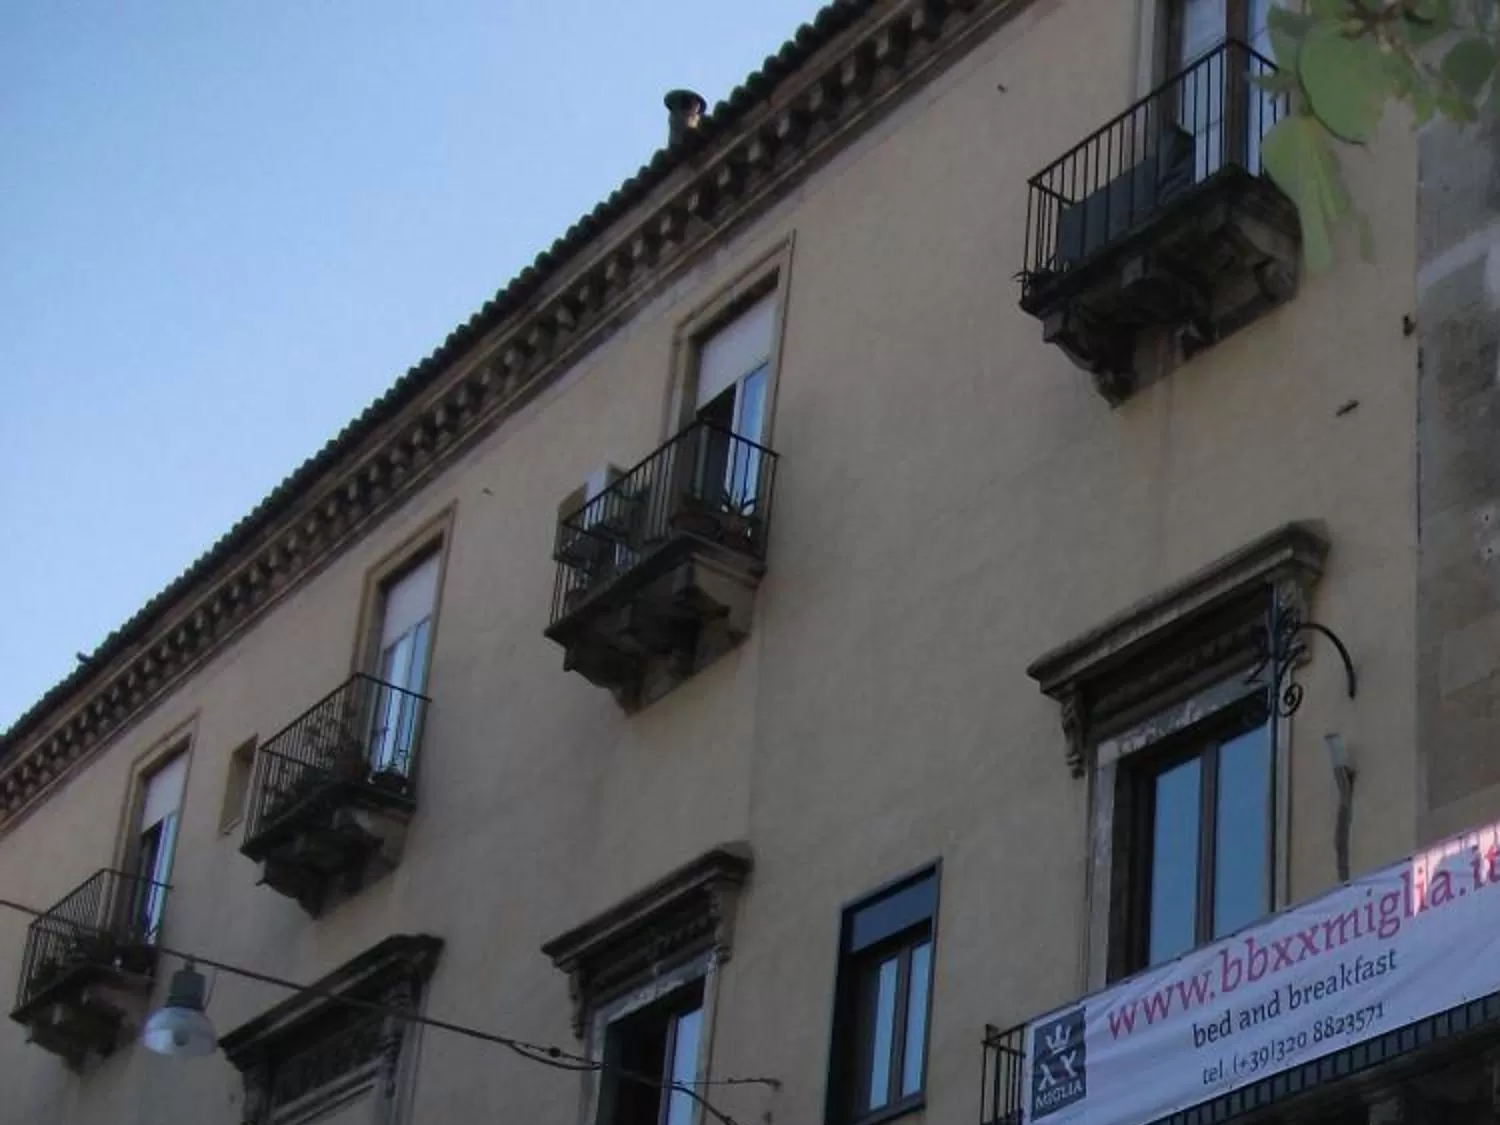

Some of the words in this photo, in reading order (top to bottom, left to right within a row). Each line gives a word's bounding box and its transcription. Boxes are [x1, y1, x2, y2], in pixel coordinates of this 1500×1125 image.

[1192, 1008, 1232, 1048] bed
[1239, 990, 1281, 1030] and
[1288, 949, 1397, 1010] breakfast
[1313, 1000, 1384, 1042] 8823571
